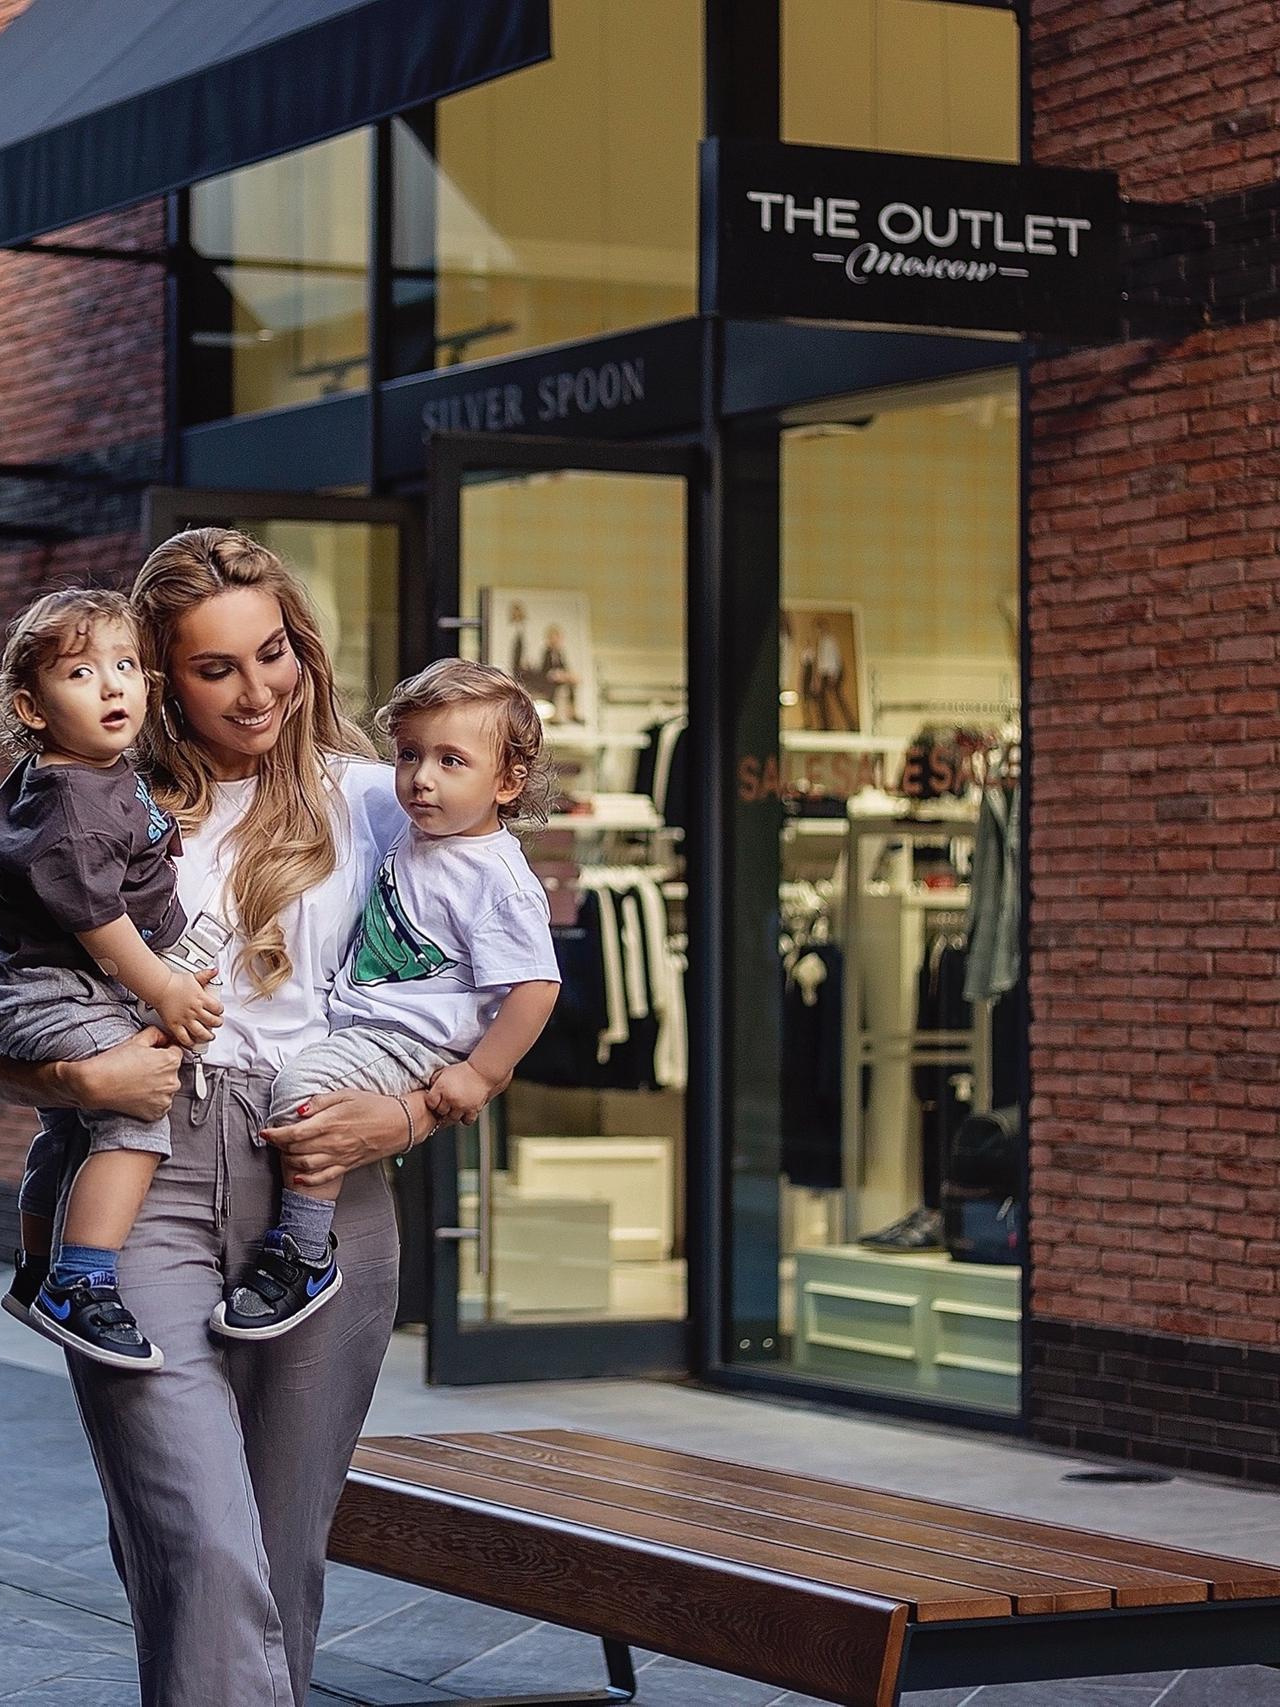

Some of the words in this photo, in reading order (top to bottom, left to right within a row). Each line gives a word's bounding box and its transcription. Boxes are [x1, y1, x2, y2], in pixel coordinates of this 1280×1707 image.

[746, 190, 860, 239] THE
[878, 202, 1092, 257] OUTLET
[845, 242, 997, 284] Moscow
[537, 358, 645, 422] SPOON
